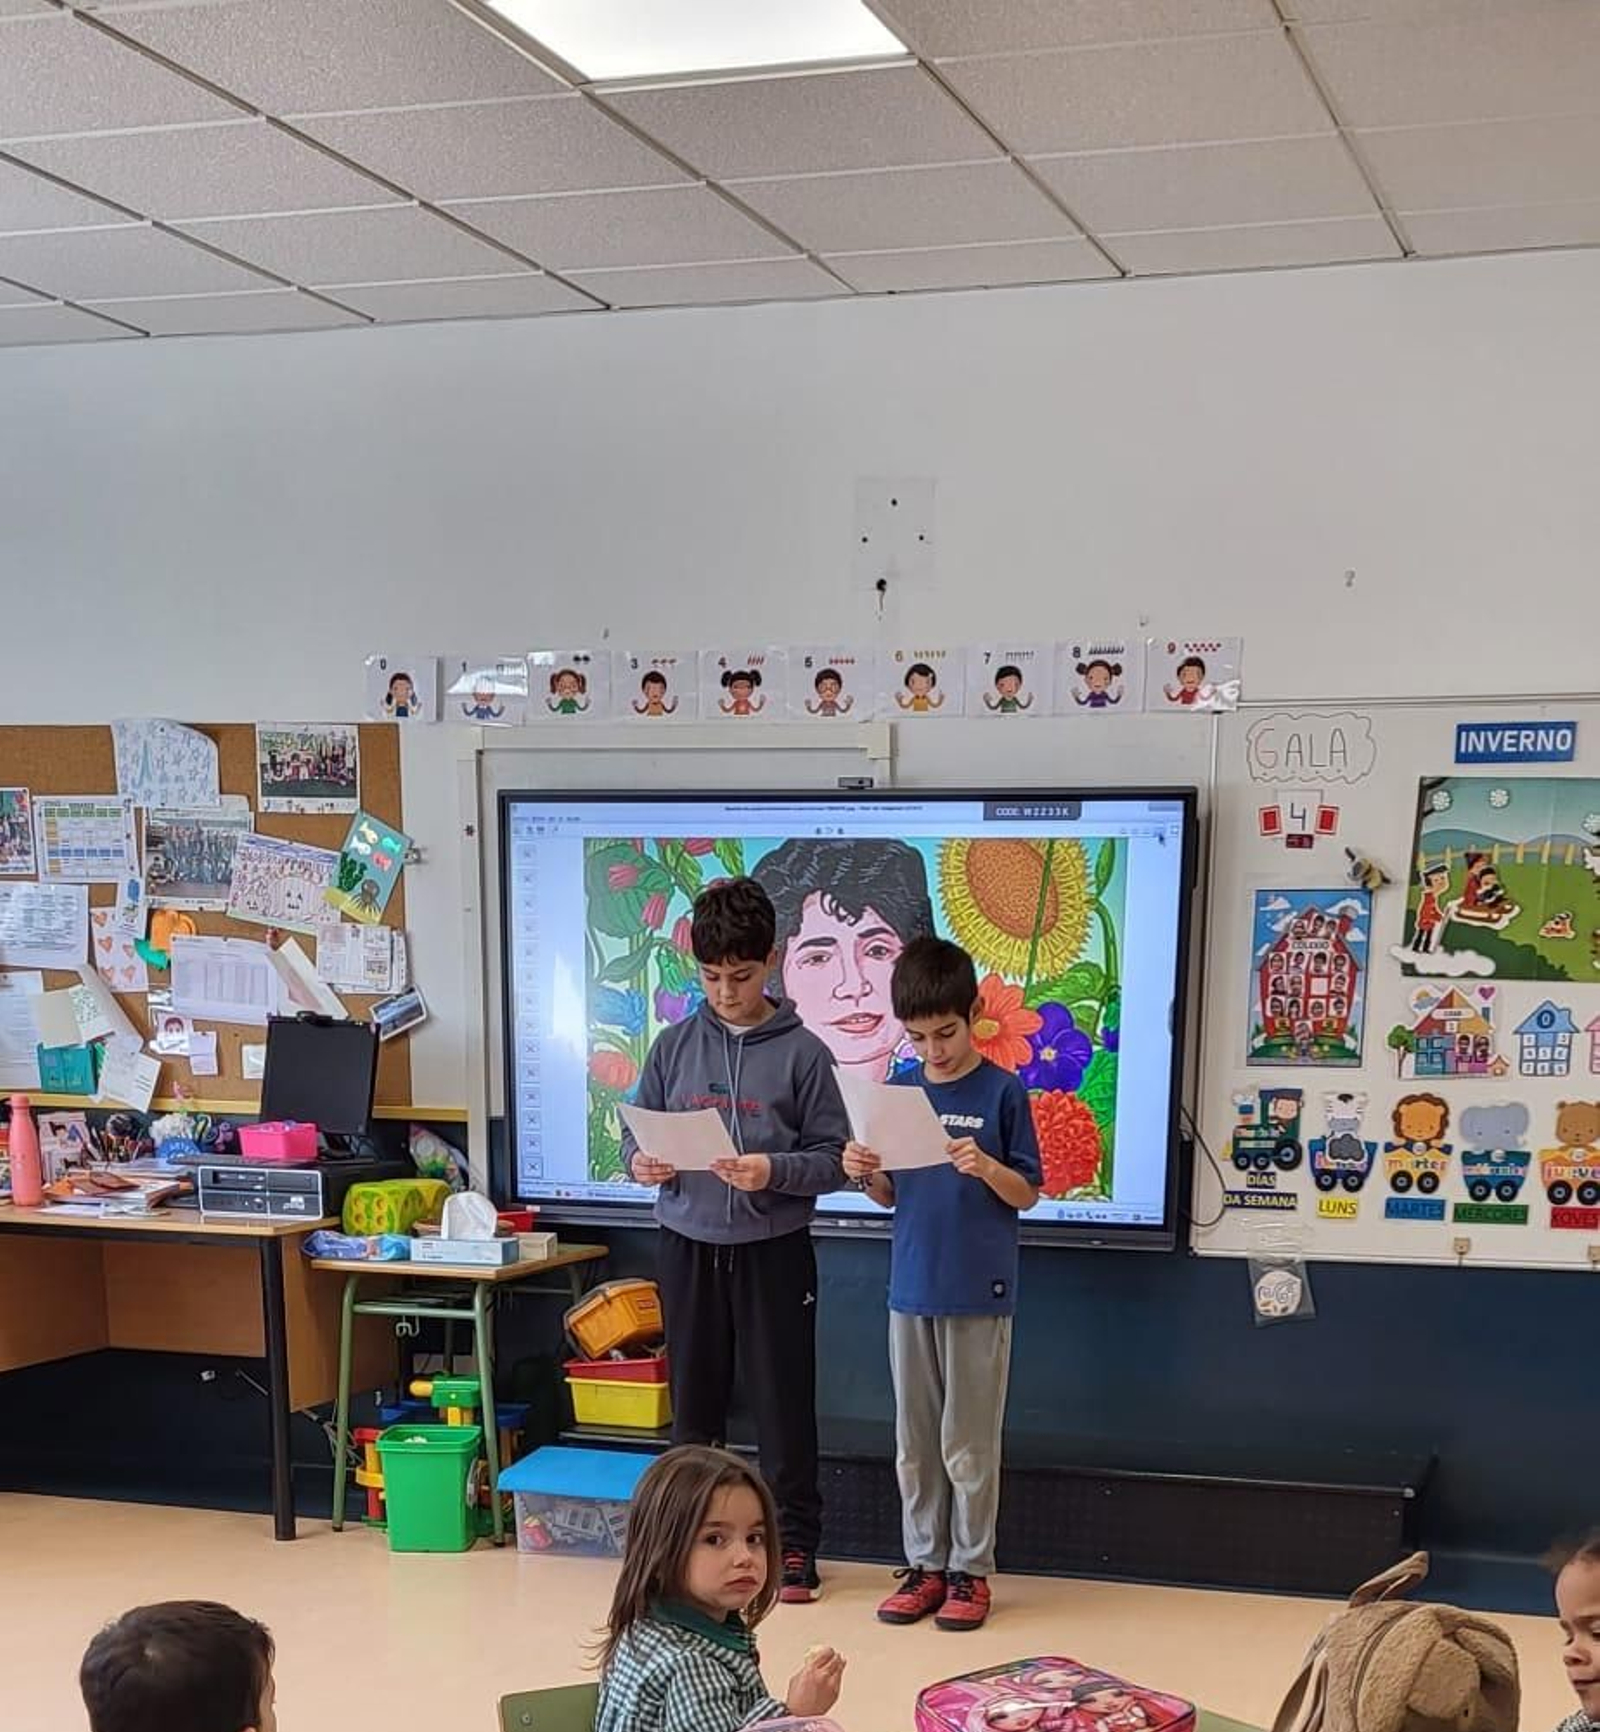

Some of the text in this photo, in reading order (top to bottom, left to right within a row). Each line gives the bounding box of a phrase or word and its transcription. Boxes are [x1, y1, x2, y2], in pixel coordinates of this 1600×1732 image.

[1254, 727, 1348, 769] GALA
[1459, 728, 1573, 753] INVERNO
[1290, 802, 1306, 832] 4
[940, 1113, 984, 1129] STARS
[1247, 1171, 1276, 1187] DÍAS
[1224, 1193, 1297, 1207] DA SEMANA
[1319, 1199, 1357, 1215] LUNS
